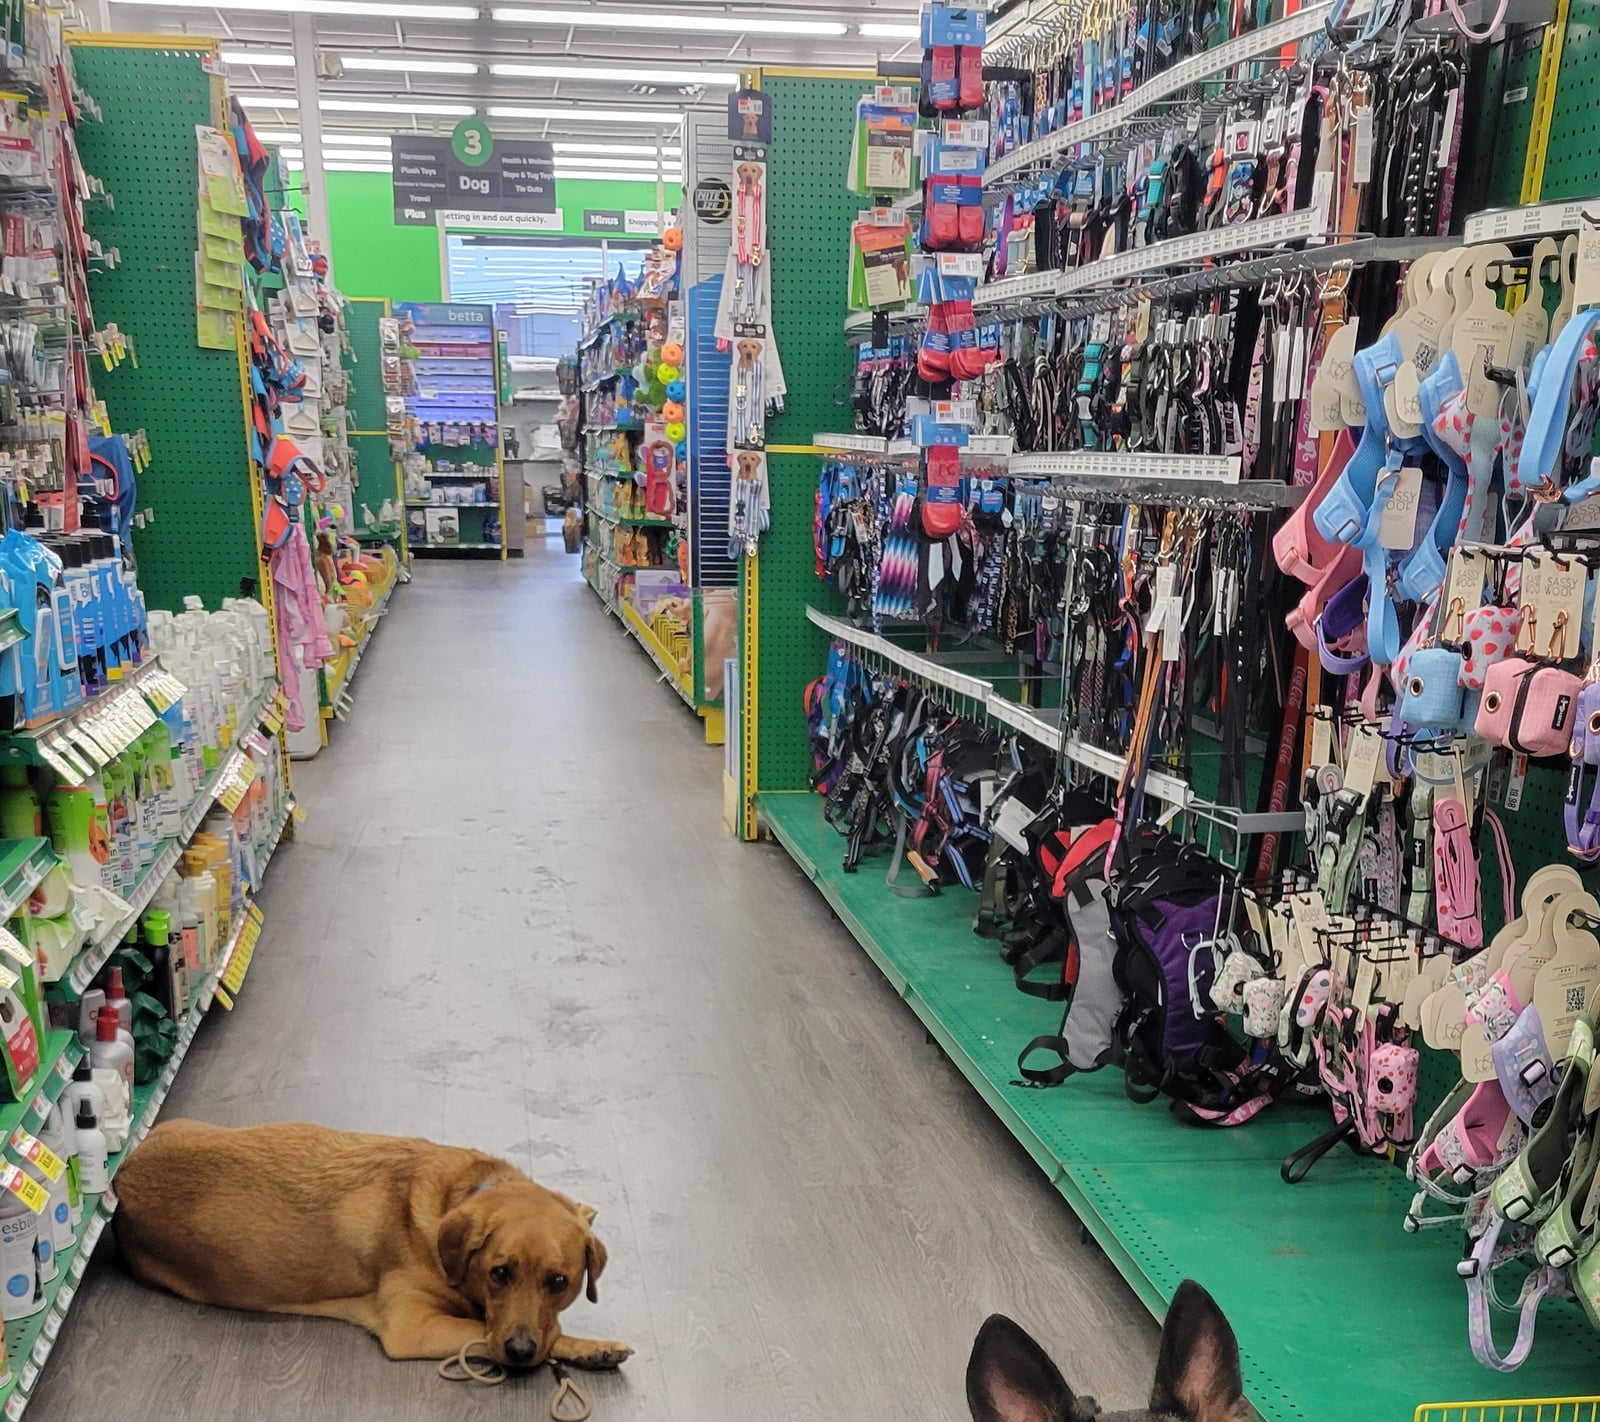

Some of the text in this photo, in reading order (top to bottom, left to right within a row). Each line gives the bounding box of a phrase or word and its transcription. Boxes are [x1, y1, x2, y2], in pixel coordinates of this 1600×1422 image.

[464, 129, 482, 156] 3
[459, 175, 490, 194] Dog
[404, 208, 426, 219] Plus
[446, 212, 471, 222] etting
[482, 213, 498, 221] and
[500, 214, 514, 222] out
[590, 213, 619, 226] Minus
[448, 309, 484, 322] betta
[1386, 500, 1413, 511] OOF
[1571, 503, 1600, 517] ASSY
[1546, 576, 1578, 590] SASSY
